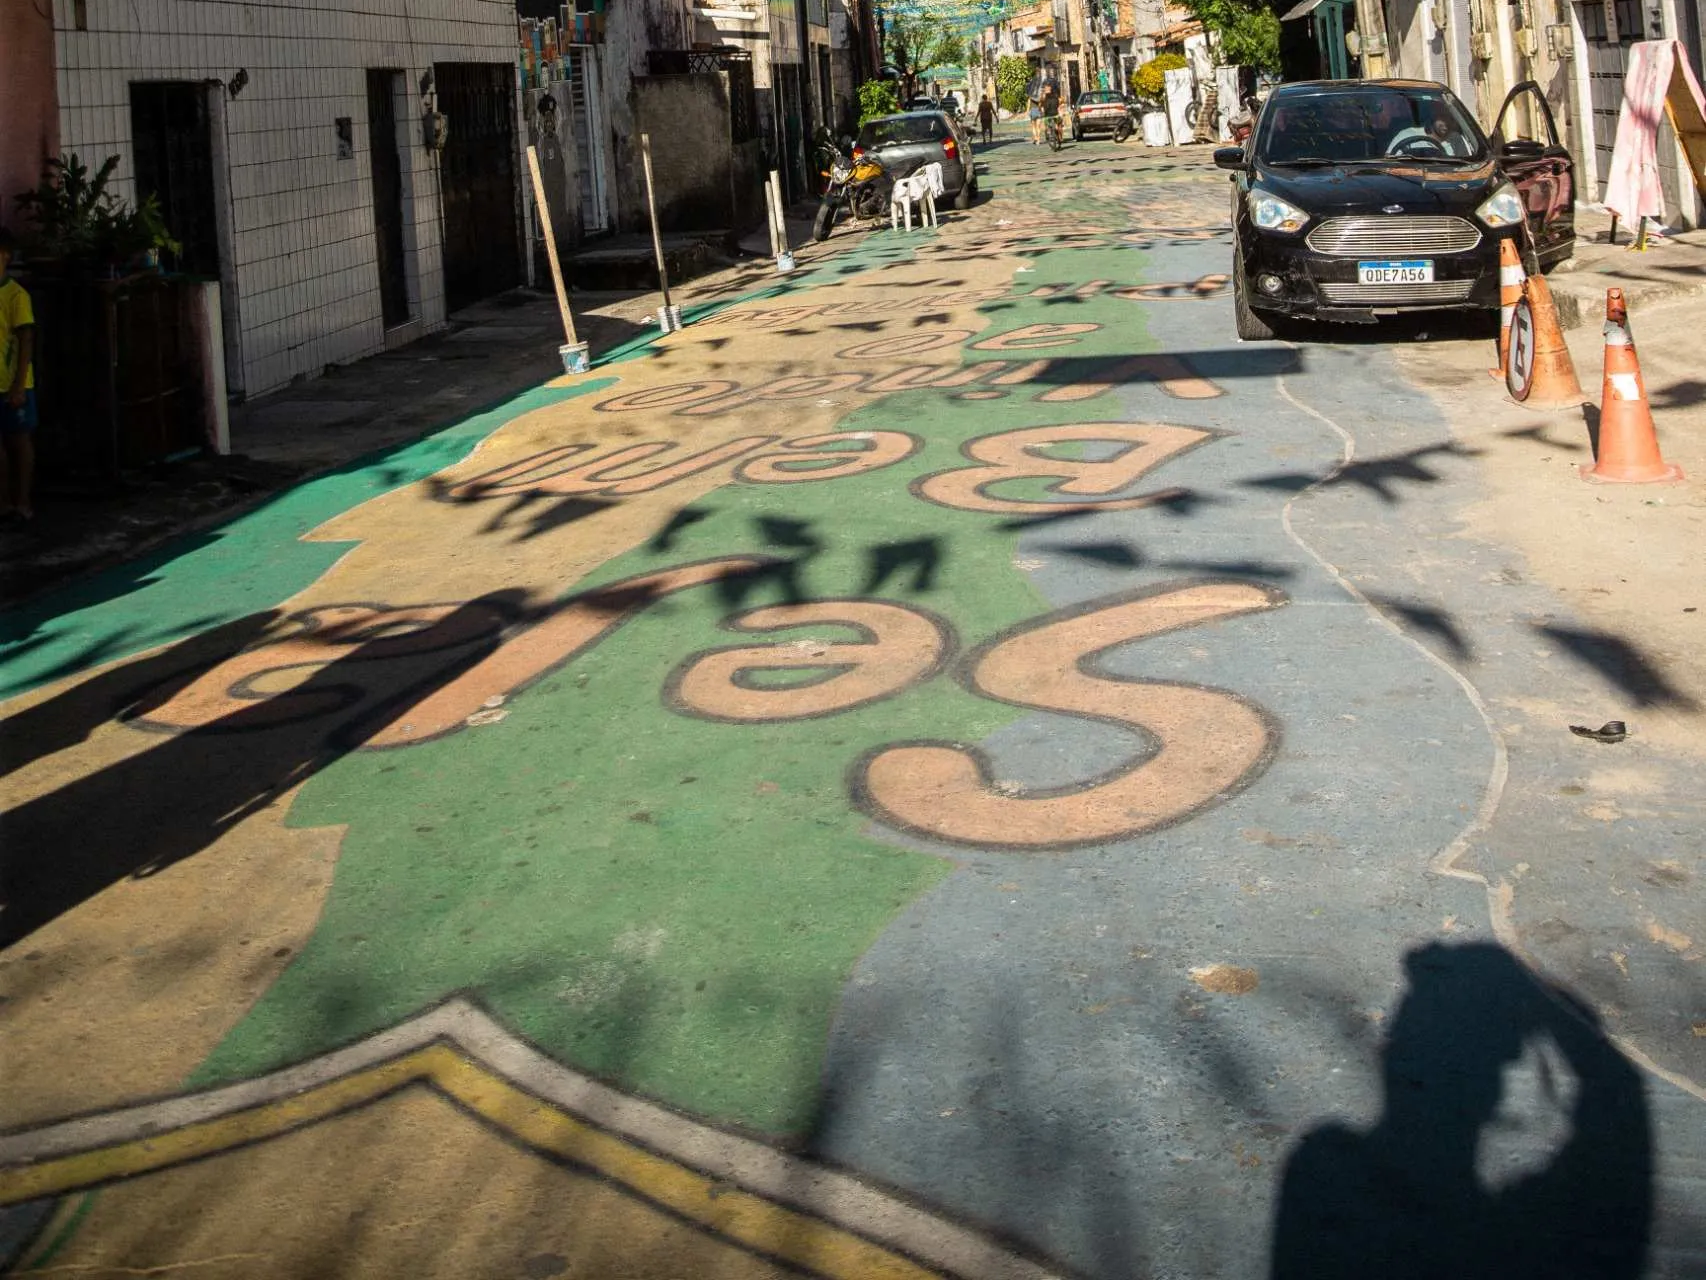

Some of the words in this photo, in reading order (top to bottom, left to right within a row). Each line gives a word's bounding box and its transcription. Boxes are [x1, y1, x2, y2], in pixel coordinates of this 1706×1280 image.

[698, 273, 1232, 327] Pirambu
[836, 321, 1105, 360] ao
[593, 353, 1232, 416] Vindo
[435, 420, 1237, 515] Bem
[114, 554, 1291, 850] Seja
